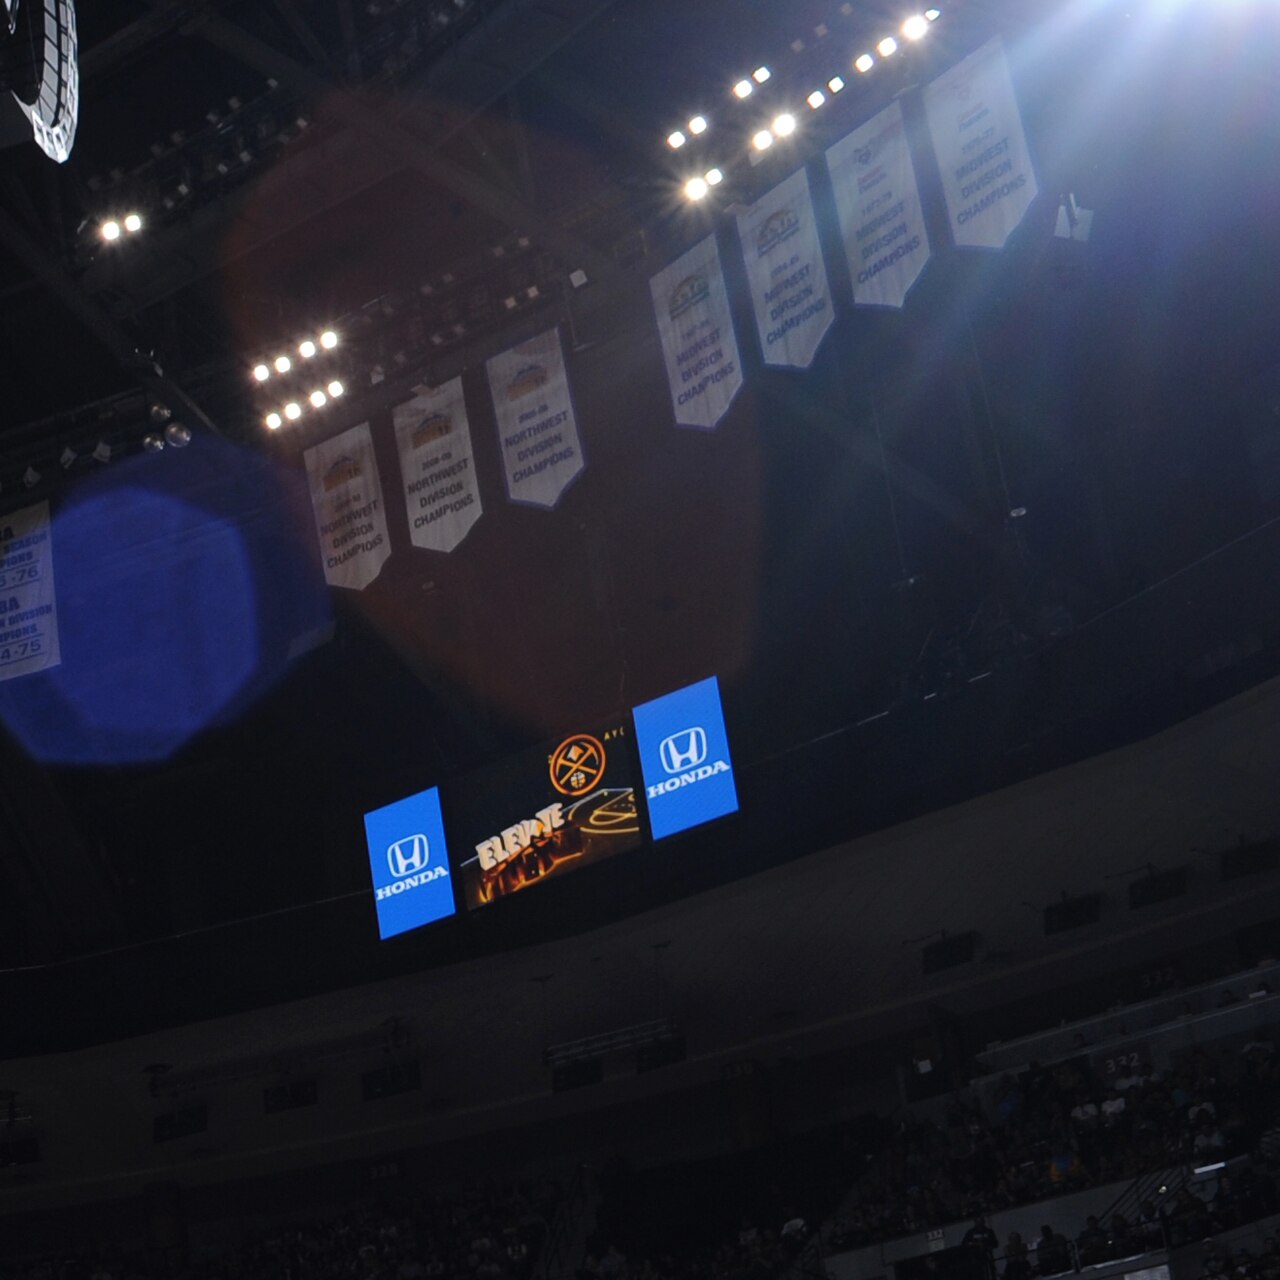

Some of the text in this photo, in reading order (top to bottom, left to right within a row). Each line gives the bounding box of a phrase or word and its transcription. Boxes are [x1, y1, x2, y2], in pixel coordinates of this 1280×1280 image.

[961, 159, 1013, 199] DIVISION
[957, 173, 1027, 227] CHAMPIONS
[856, 203, 905, 242] MIDWEST
[862, 222, 908, 261] DIVISION
[858, 236, 921, 285] CHAMPIONS
[764, 265, 812, 304] MIDWEST
[767, 299, 827, 345] CHAMPIONS
[770, 286, 813, 322] DIVISION
[676, 328, 721, 366] MIDWEST
[677, 362, 735, 405] CHAMPIONS
[681, 349, 724, 384] DIVISION
[504, 410, 569, 448] NORTHWEST
[517, 433, 563, 461] DIVISION
[407, 458, 469, 495] NORTHWEST
[512, 447, 575, 483] CHAMPIONS
[413, 493, 474, 529] CHAMPIONS
[419, 481, 464, 509] DIVISION
[320, 501, 378, 537] NORTHWEST
[332, 522, 375, 548] DIVISION
[3, 531, 48, 556] SEASON
[327, 534, 383, 568] CHAMPIONS
[8, 604, 53, 628] DIVISION
[646, 759, 731, 800] HONDA
[376, 866, 449, 901] HONDA
